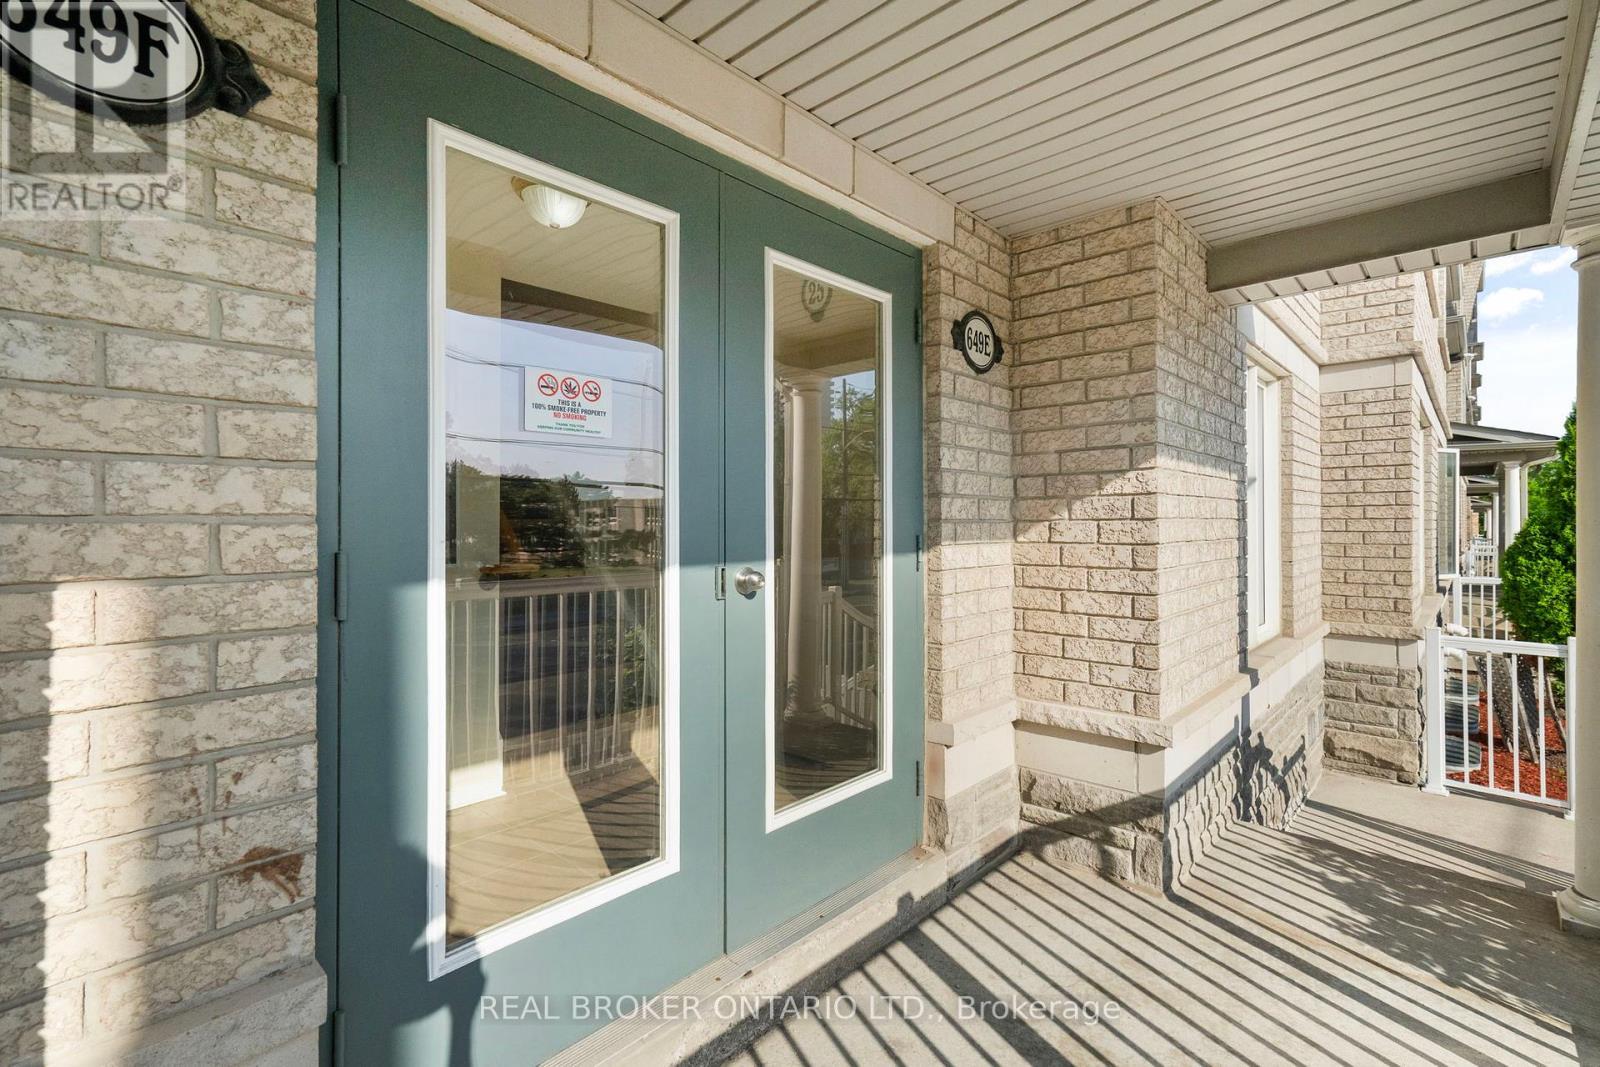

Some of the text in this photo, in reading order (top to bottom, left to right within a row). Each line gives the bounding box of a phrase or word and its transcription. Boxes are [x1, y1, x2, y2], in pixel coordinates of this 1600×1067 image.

[966, 326, 992, 358] 649E
[557, 398, 570, 407] THIS
[532, 402, 607, 417] 100% SMOKE-FREE PROPERTY
[562, 413, 587, 421] SMOKING
